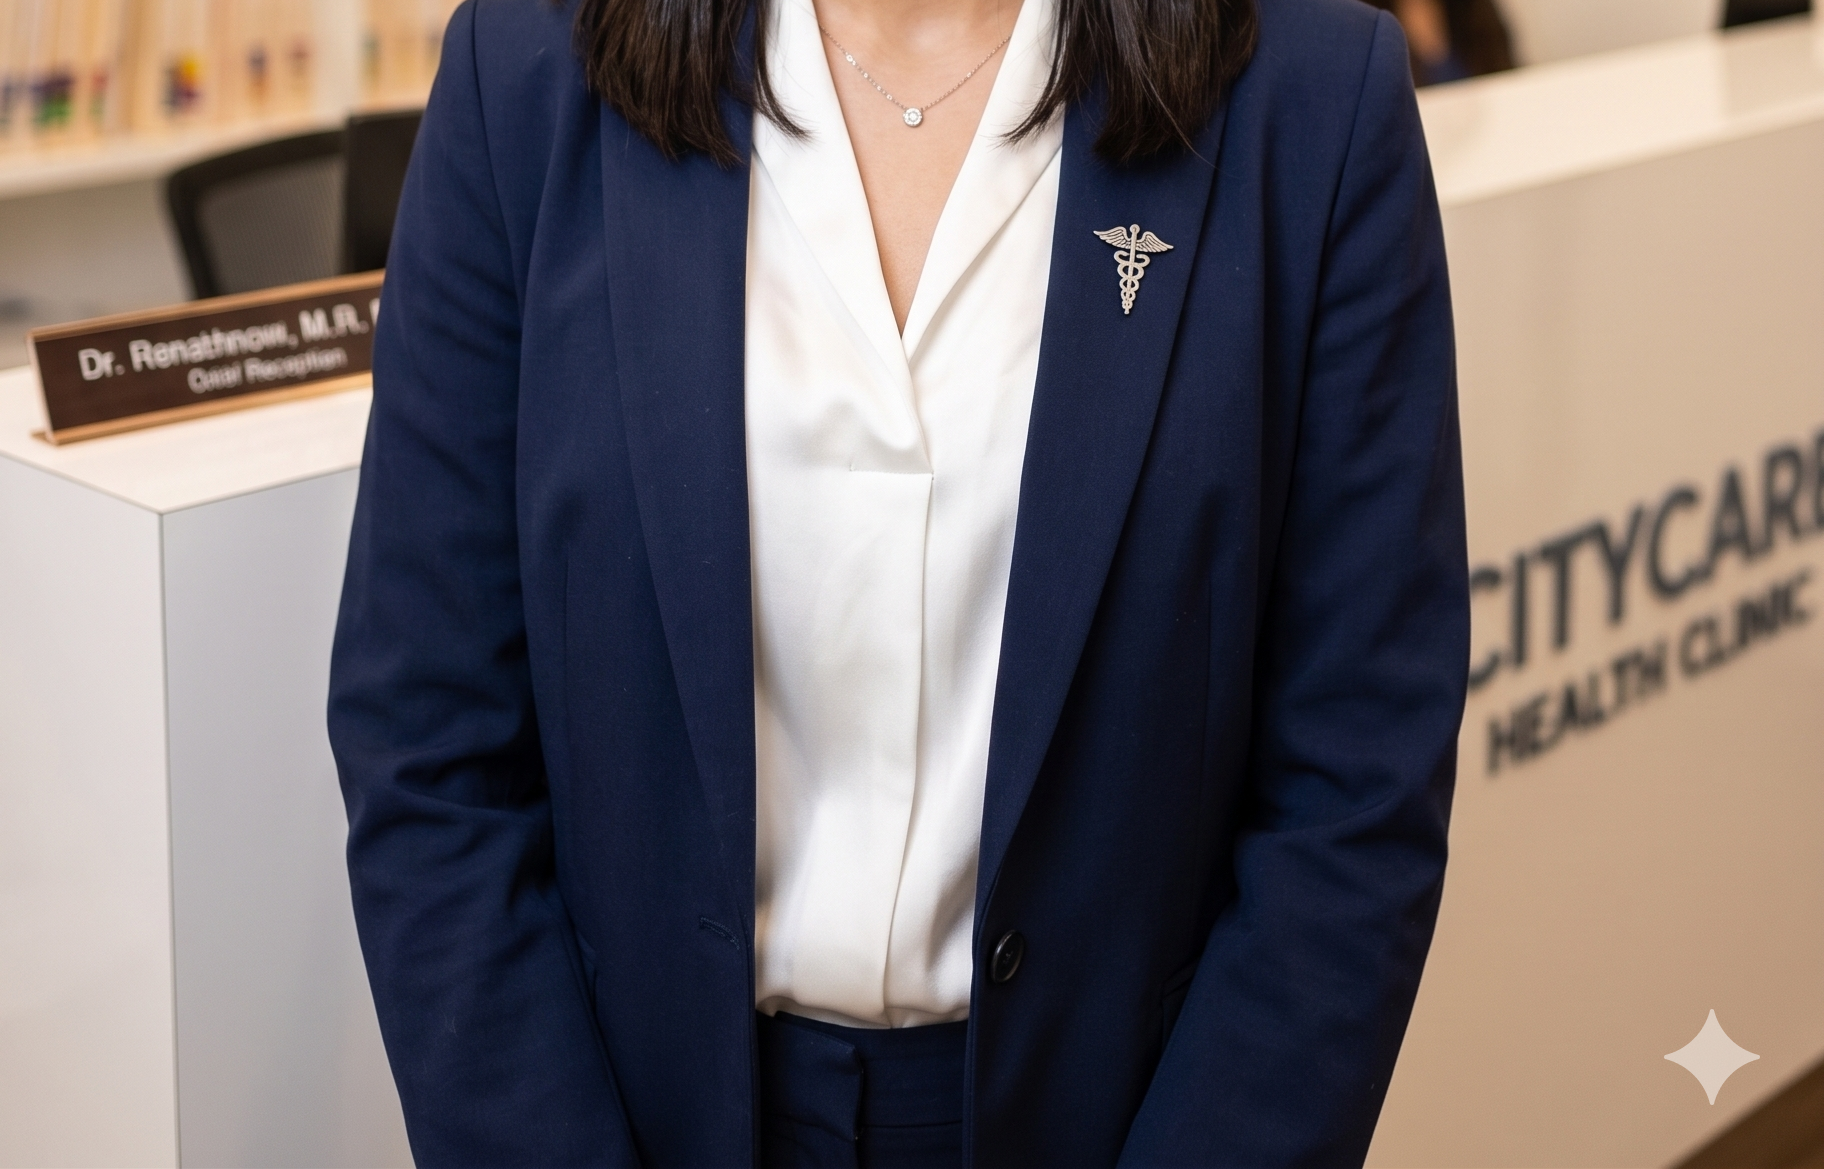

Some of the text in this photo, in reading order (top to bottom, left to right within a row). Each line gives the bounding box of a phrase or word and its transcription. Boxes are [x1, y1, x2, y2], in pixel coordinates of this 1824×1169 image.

[78, 347, 126, 381] Dr.
[1468, 425, 1824, 695] CITYCAR
[1486, 567, 1813, 778] HEALTH CLINIC
